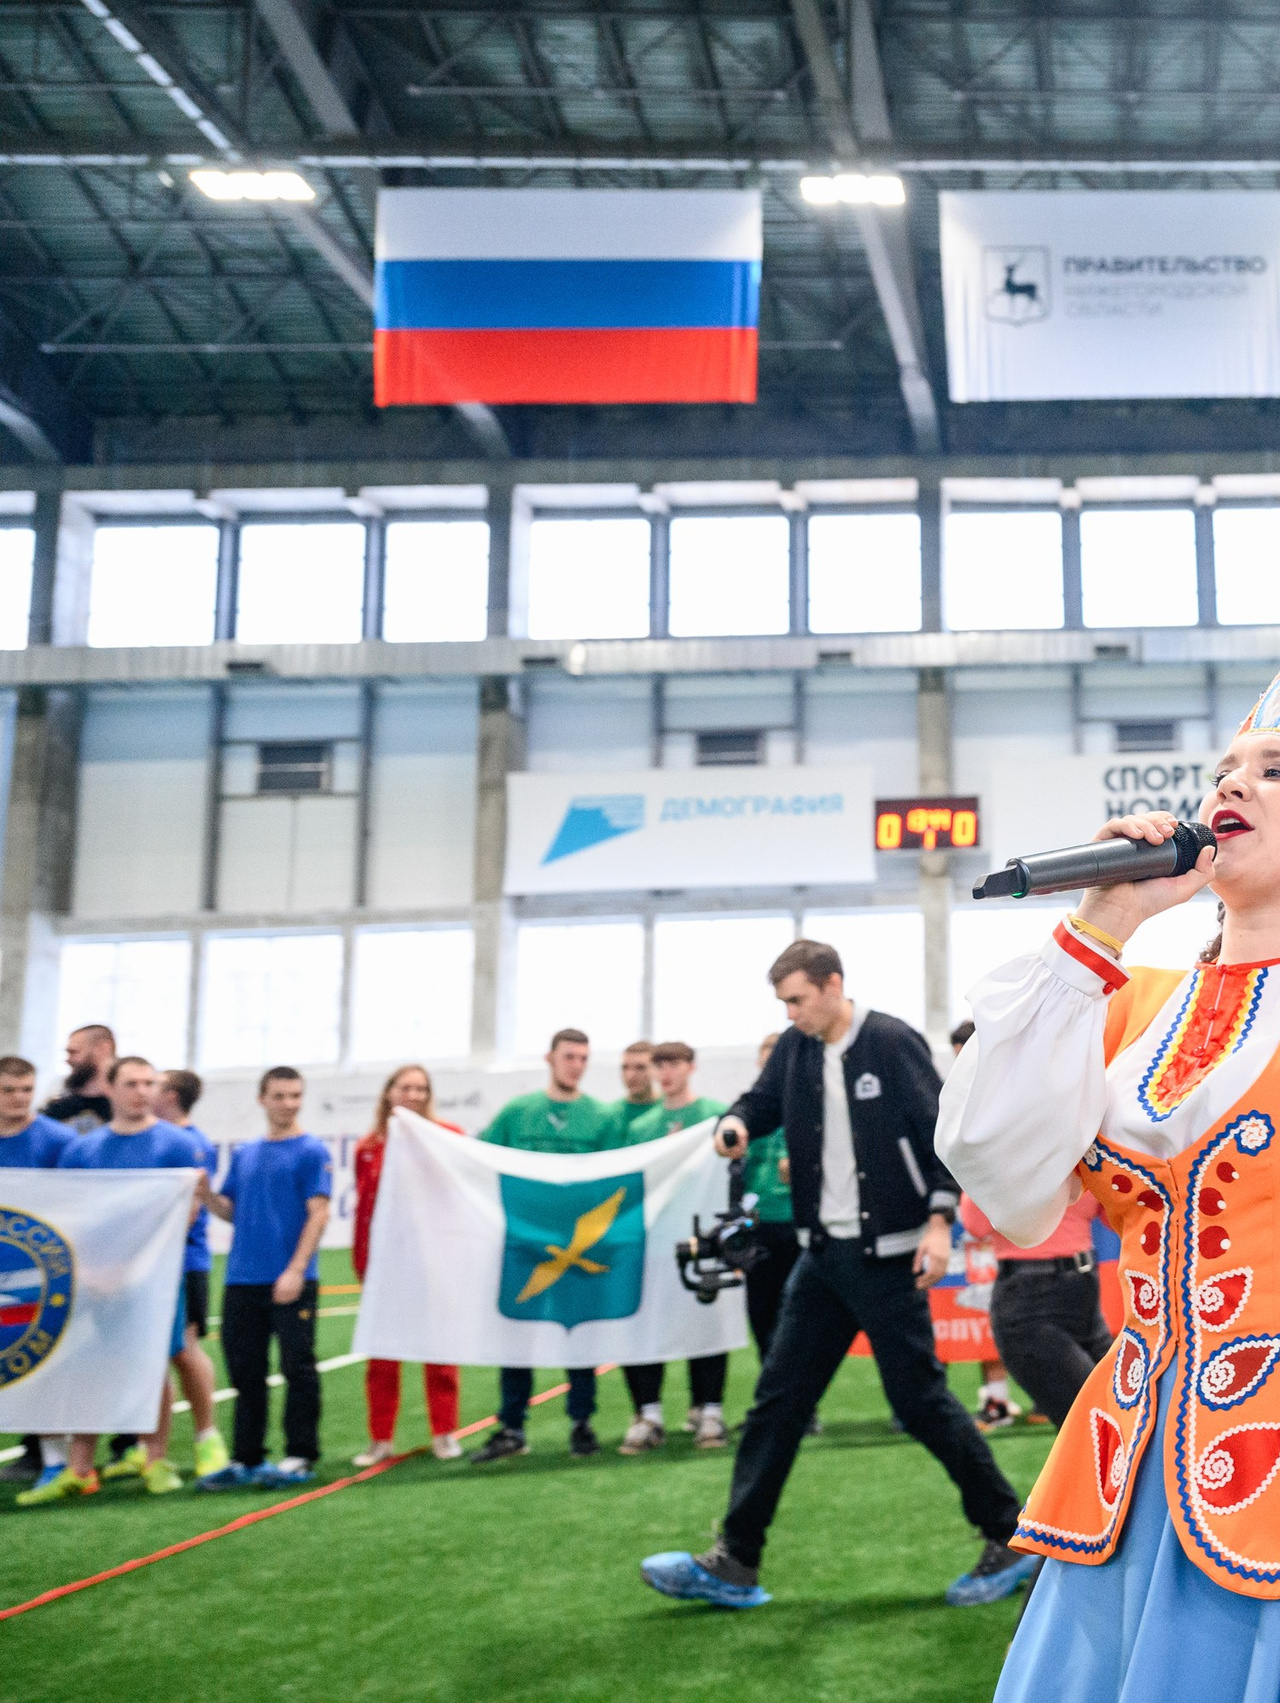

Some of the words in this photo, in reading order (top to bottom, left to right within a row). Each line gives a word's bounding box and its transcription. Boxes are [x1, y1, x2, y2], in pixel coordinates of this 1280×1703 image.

[1063, 256, 1268, 275] ПРАВИТЕЛЬСТВО
[1104, 764, 1203, 792] СПОРТ
[660, 793, 843, 822] ДЕМОГРАФИЯ
[1105, 797, 1202, 824] НОРМ
